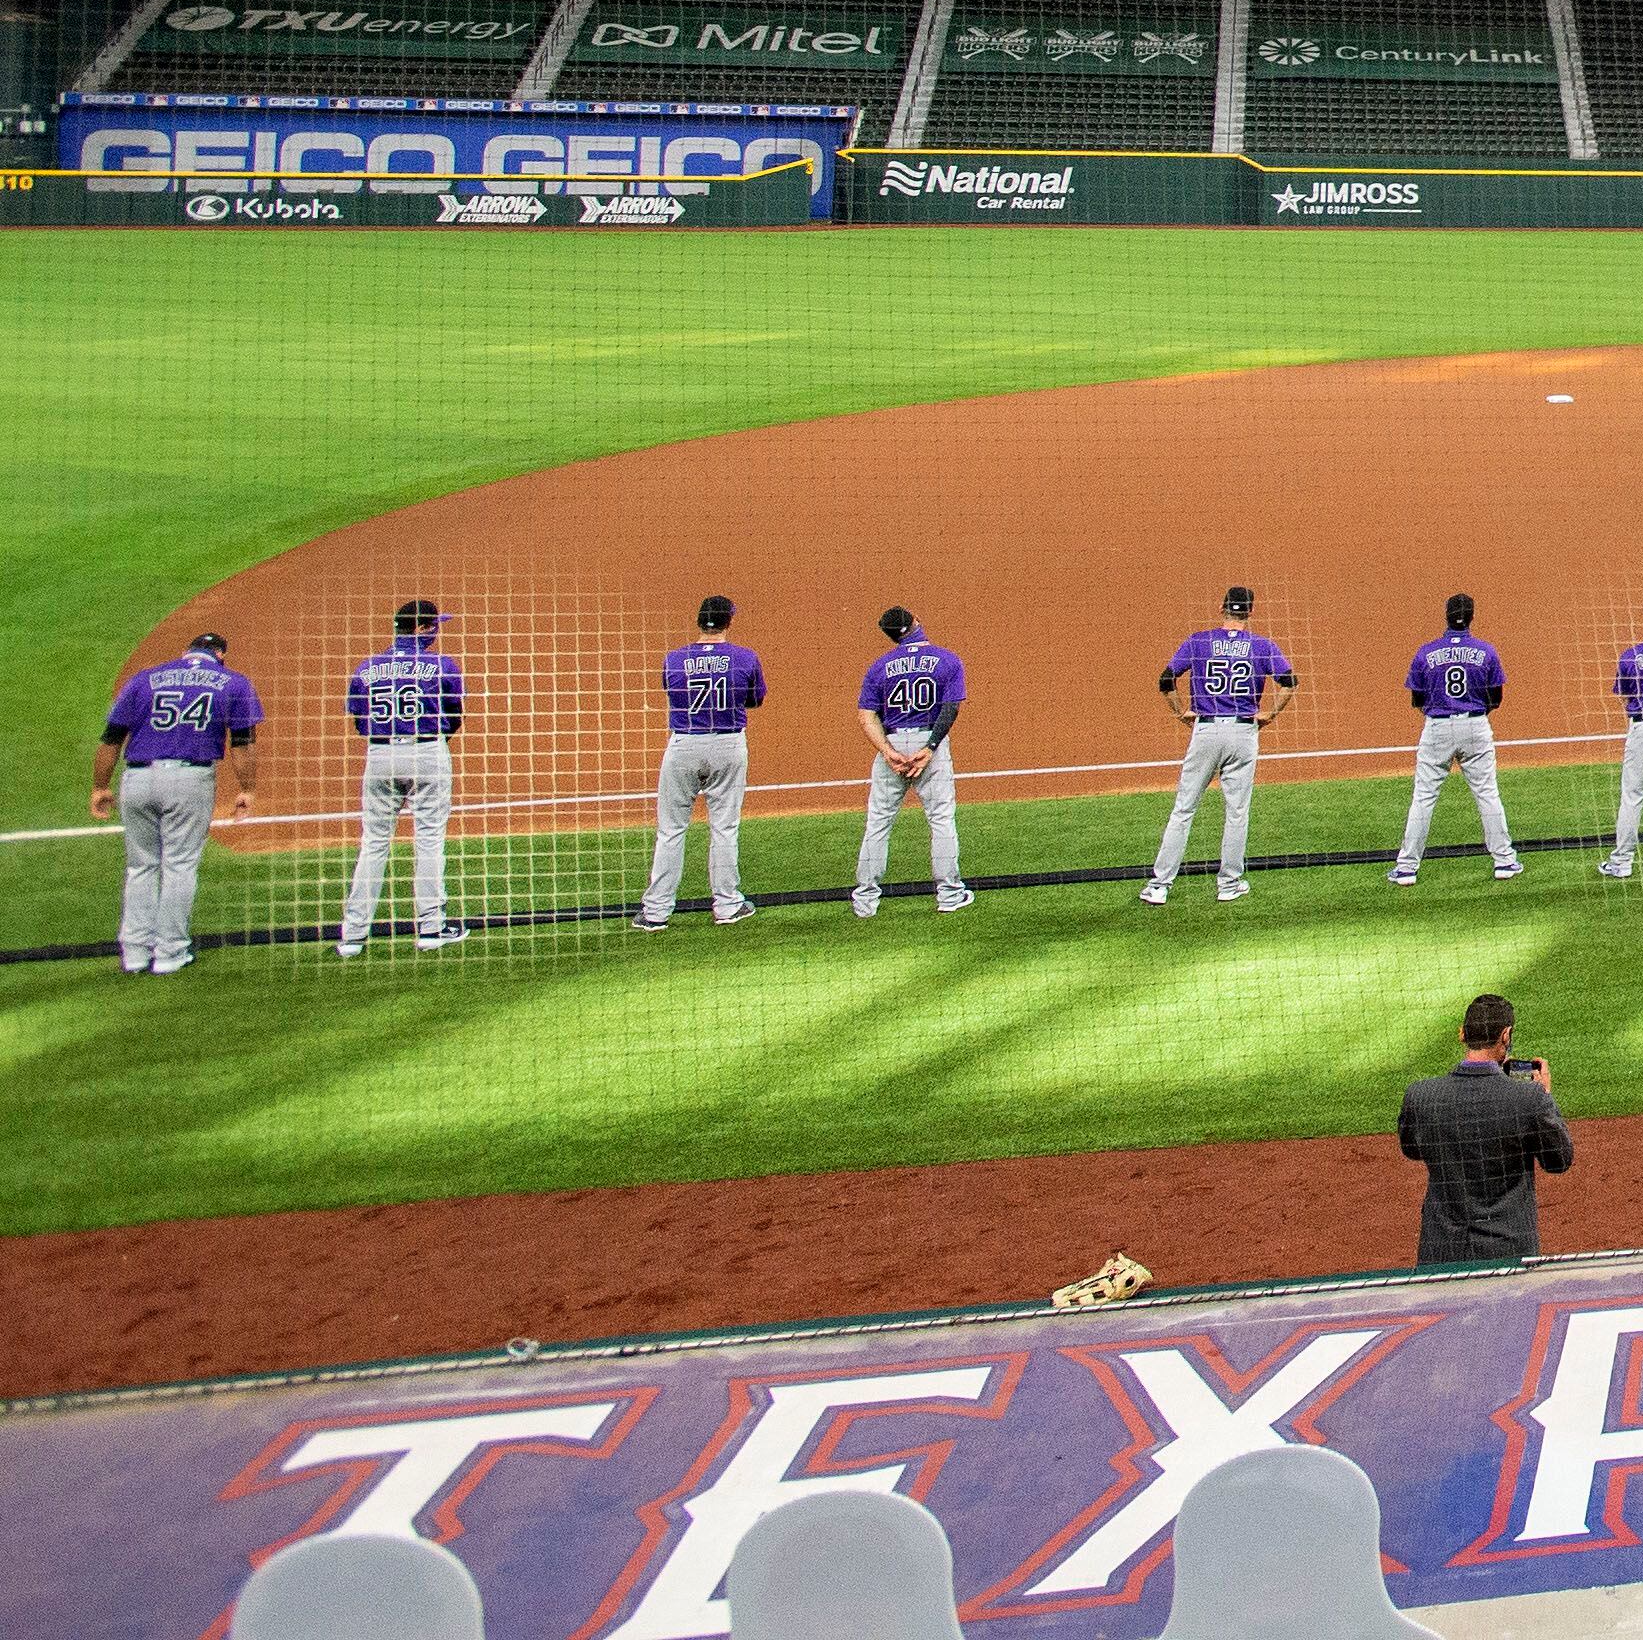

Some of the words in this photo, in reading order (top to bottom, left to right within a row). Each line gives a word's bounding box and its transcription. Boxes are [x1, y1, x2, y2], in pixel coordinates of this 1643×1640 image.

[697, 23, 883, 55] Mitel
[1336, 46, 1544, 65] CenturyLink
[82, 94, 135, 105] GEICO
[176, 95, 229, 106] GEICO
[267, 96, 319, 108] GEICO
[358, 97, 408, 109] GEICO
[445, 99, 493, 111] GEICO
[531, 102, 578, 112] GEICO
[614, 103, 661, 113] GEICO
[697, 104, 742, 114] GEICO
[777, 105, 820, 115] GEICO
[80, 129, 455, 194] GEICO
[482, 134, 823, 196] GEICO
[236, 197, 341, 219] Kubota
[467, 196, 532, 214] ARROW
[609, 196, 672, 214] ARROW
[977, 197, 1006, 209] Car
[1011, 197, 1065, 210] Rental
[1303, 205, 1324, 214] LAW
[1327, 206, 1361, 215] GROUP
[1212, 640, 1249, 657] BARD
[684, 656, 731, 674] DAVIS
[886, 656, 940, 678] KINLEY
[1426, 648, 1487, 668] FUENTES
[1205, 660, 1251, 696] 52
[1445, 666, 1467, 698] 8
[688, 677, 727, 714] 71
[888, 676, 936, 713] 40
[152, 691, 213, 732] 54
[369, 685, 425, 723] 56
